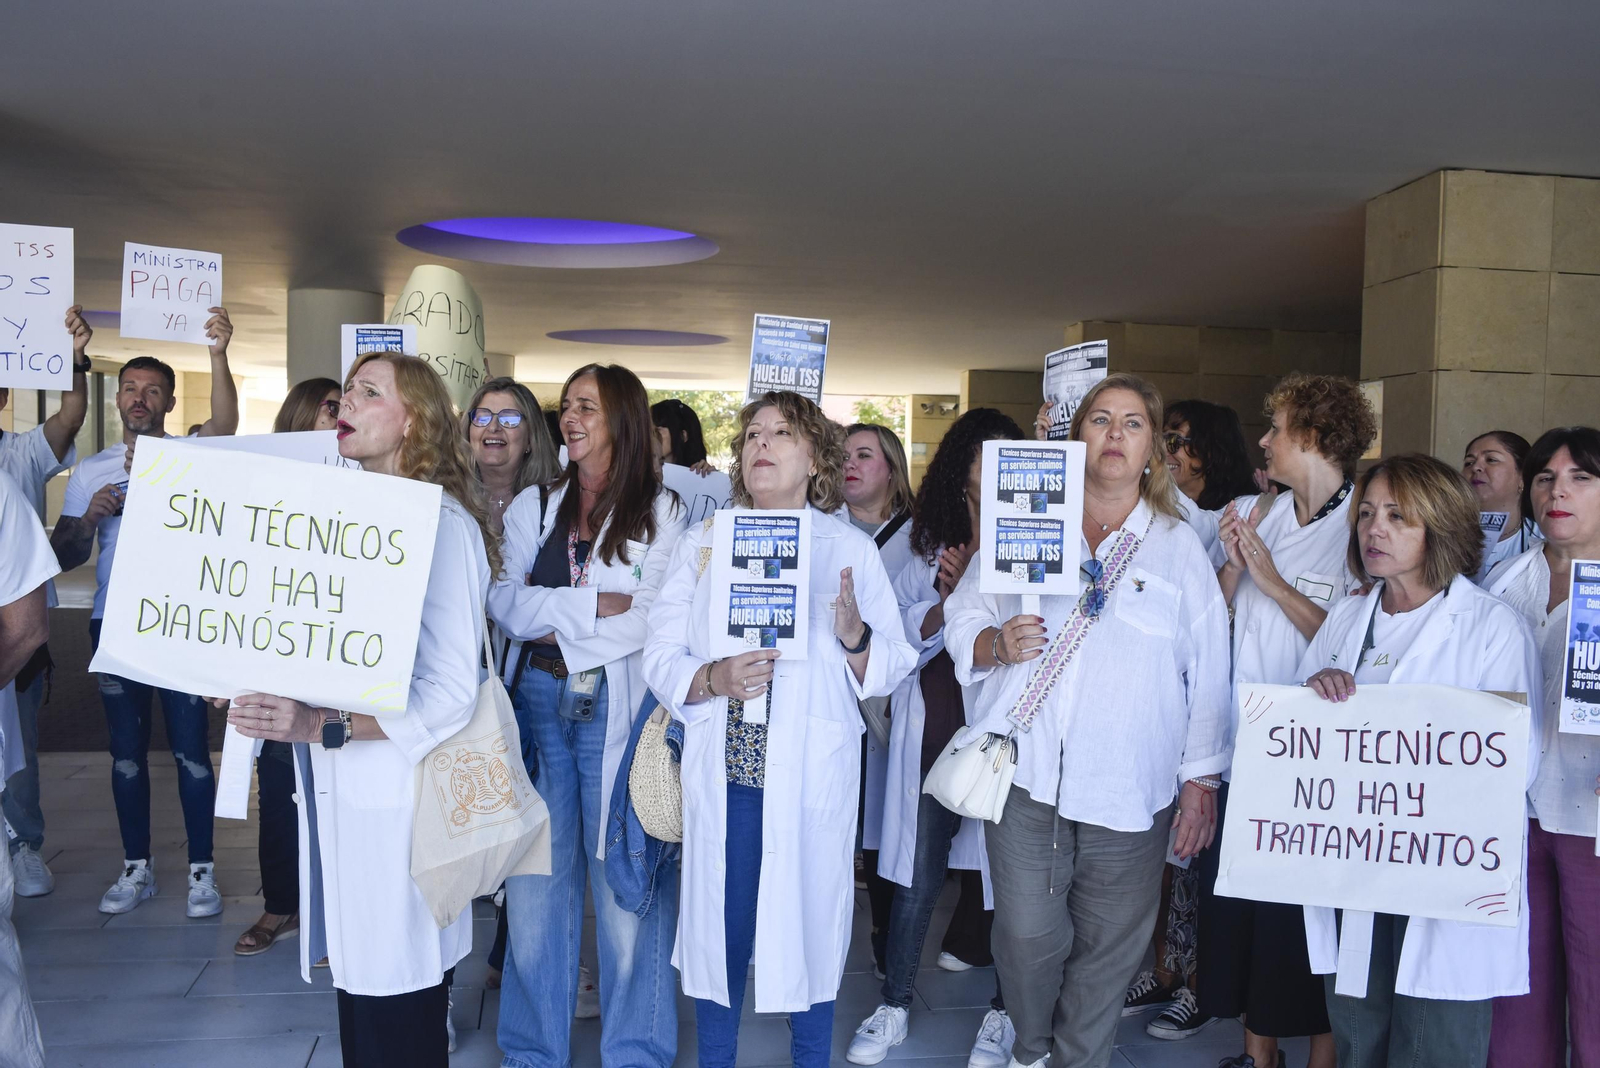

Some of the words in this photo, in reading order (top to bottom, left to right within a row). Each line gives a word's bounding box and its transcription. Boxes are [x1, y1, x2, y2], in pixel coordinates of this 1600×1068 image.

[14, 242, 55, 258] TSS
[134, 251, 217, 272] MINISTRA
[131, 270, 212, 304] PAGA
[163, 313, 187, 331] YA
[753, 363, 796, 385] HUELGA
[799, 367, 820, 387] TSS
[1002, 449, 1020, 457] Técnicos
[1020, 450, 1042, 458] Superiores
[1001, 462, 1008, 470] en
[1009, 460, 1036, 470] servicios
[1038, 460, 1062, 470] mínimos
[1000, 473, 1040, 490] HUELGA
[1044, 474, 1062, 491] TSS
[163, 489, 226, 536] SIN
[243, 500, 405, 565] TÉCNICOS
[744, 528, 771, 537] servicios
[999, 519, 1017, 527] Técnicos
[1018, 520, 1040, 528] Superiores
[999, 532, 1006, 540] en
[1008, 530, 1034, 540] servicios
[1036, 530, 1060, 540] mínimos
[735, 540, 774, 557] HUELGA
[777, 540, 796, 557] TSS
[998, 543, 1037, 560] HUELGA
[1040, 544, 1060, 561] TSS
[199, 555, 248, 598] NO
[272, 566, 345, 613] HAY
[740, 596, 767, 605] servicios
[731, 608, 770, 626] HUELGA
[774, 608, 792, 626] TSS
[137, 594, 383, 667] DIAGNÓSTICO
[1573, 641, 1600, 670] HU
[1572, 680, 1580, 688] 30
[1581, 682, 1586, 690] y
[1586, 681, 1592, 690] 31
[1266, 718, 1321, 760] SIN
[1335, 721, 1507, 768] TÉCNICOS
[1294, 777, 1335, 810] NO
[1357, 781, 1425, 817] HAY
[1249, 818, 1501, 871] TRATAMIENTOS
